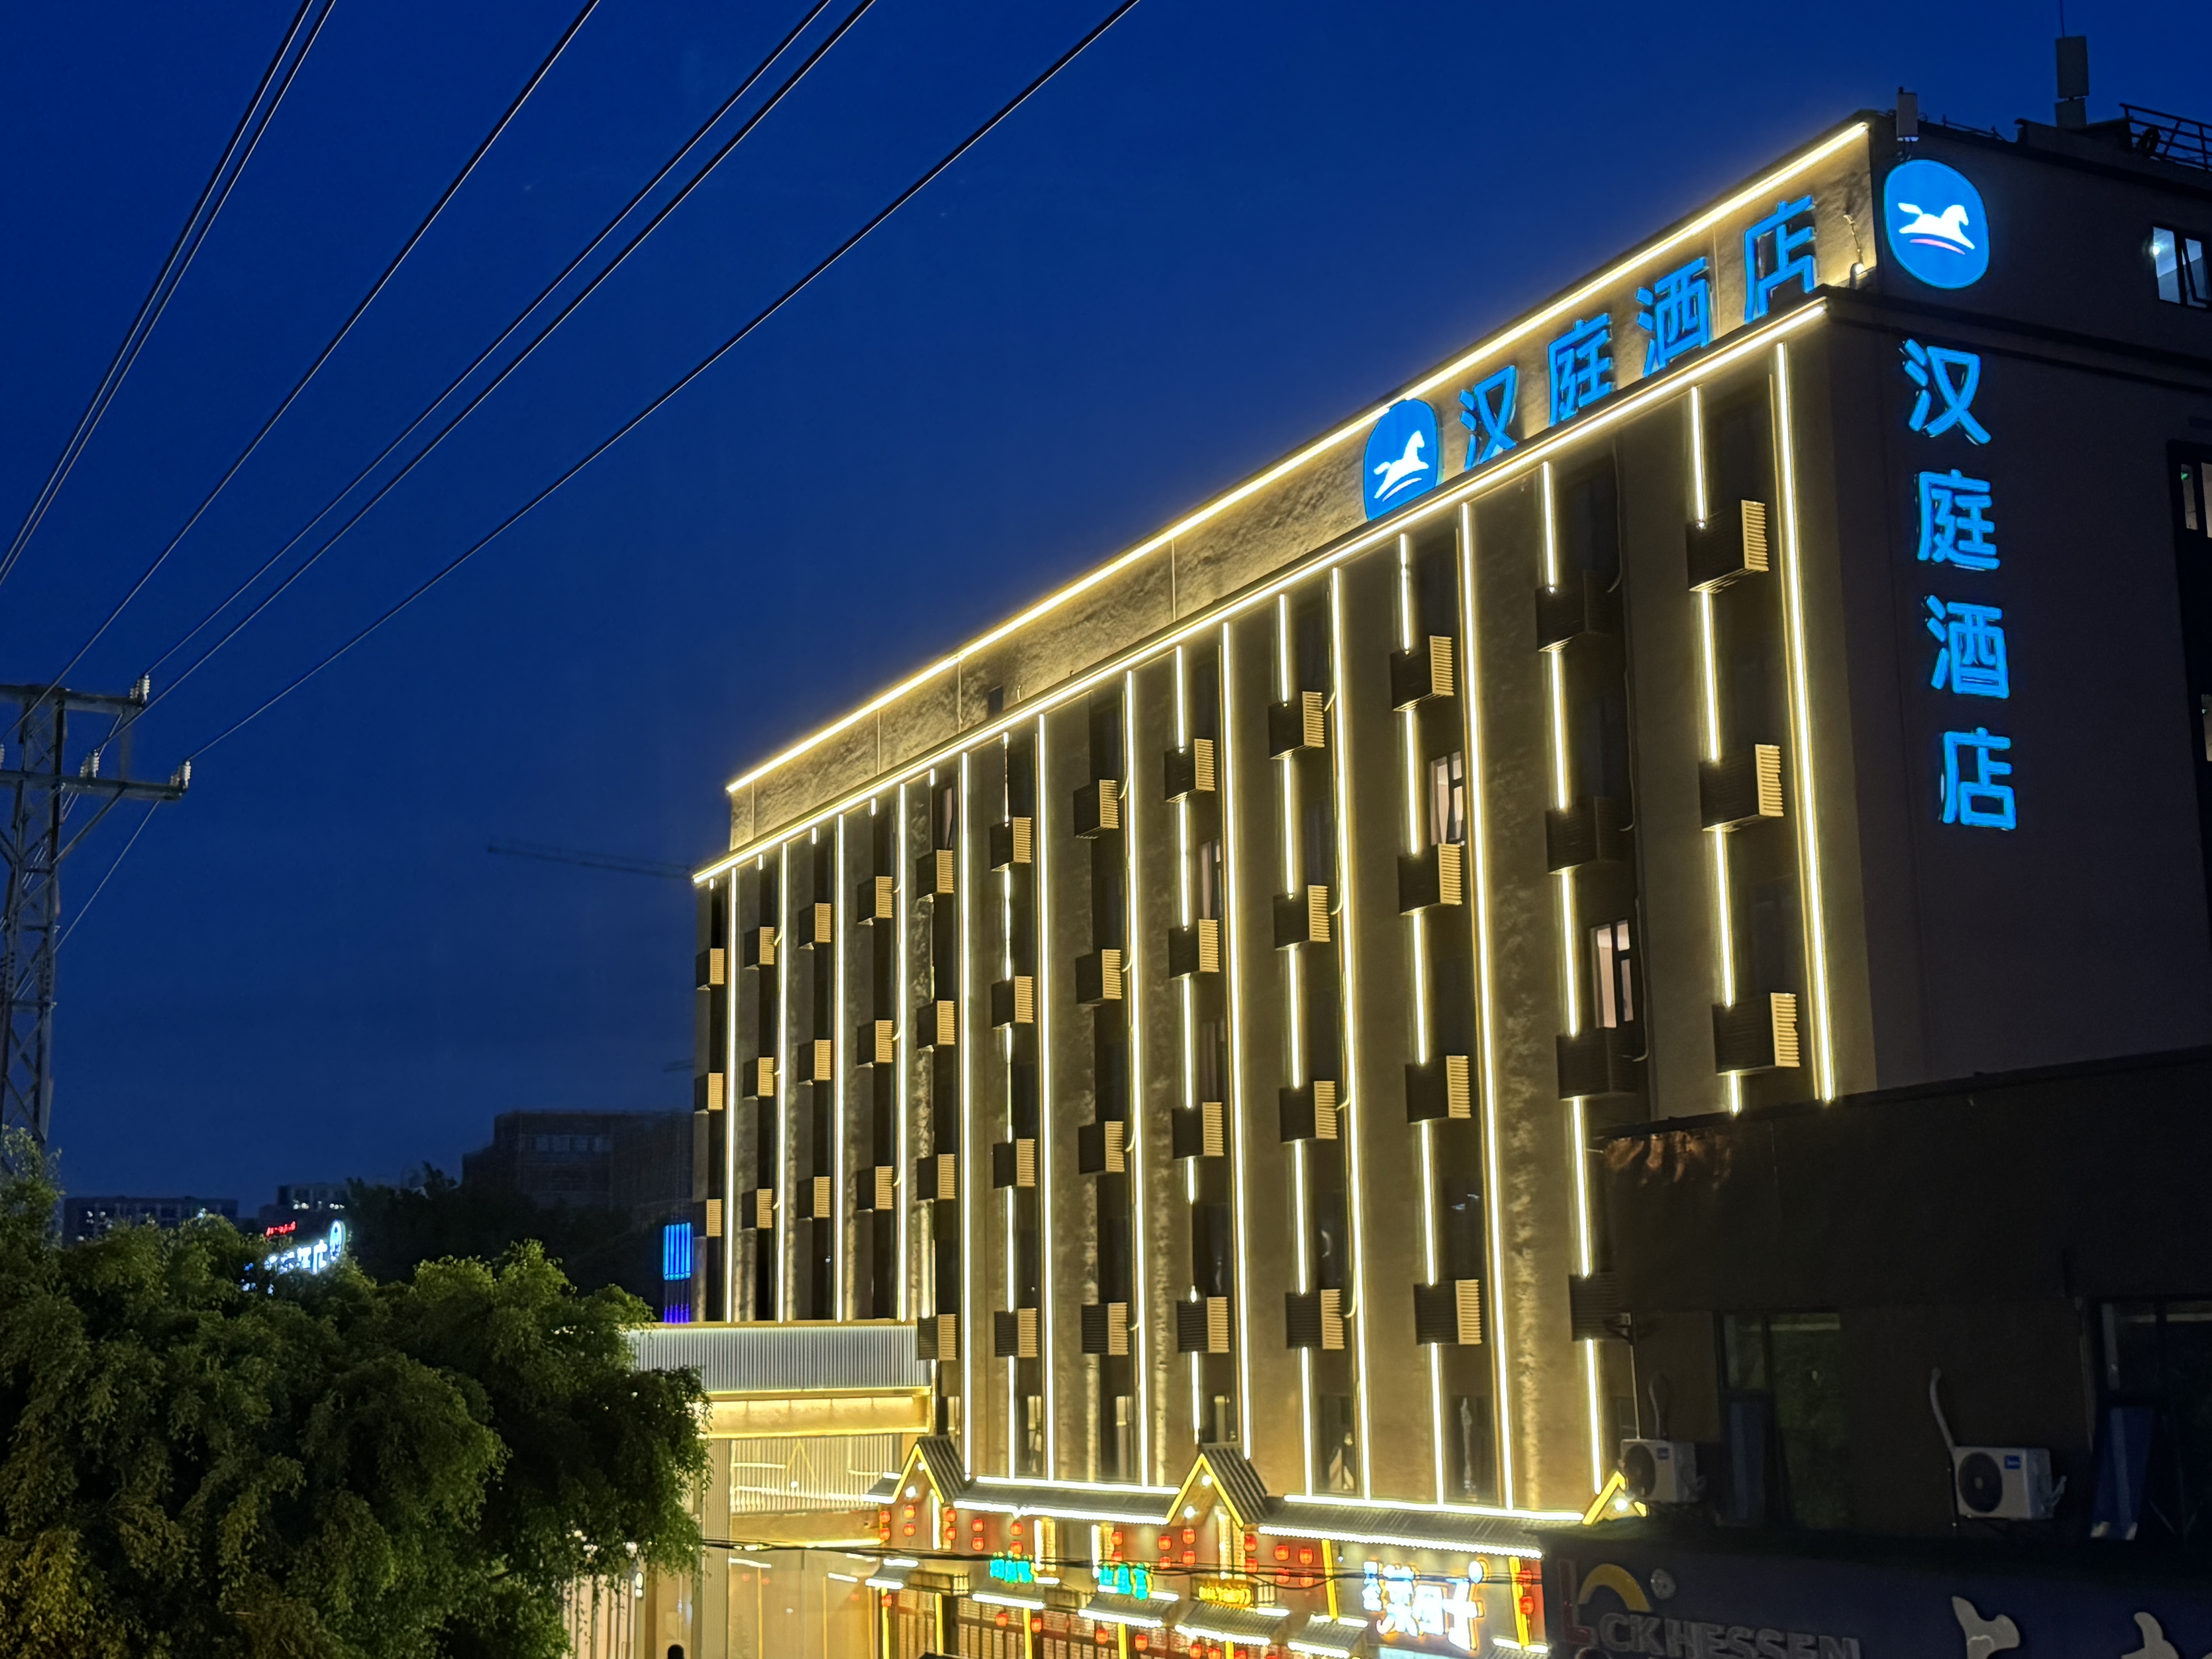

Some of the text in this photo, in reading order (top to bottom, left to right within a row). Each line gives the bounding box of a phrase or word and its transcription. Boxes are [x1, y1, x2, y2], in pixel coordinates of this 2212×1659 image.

[1459, 195, 1816, 471] 汉庭酒店
[1903, 338, 2017, 830] 汉庭酒店
